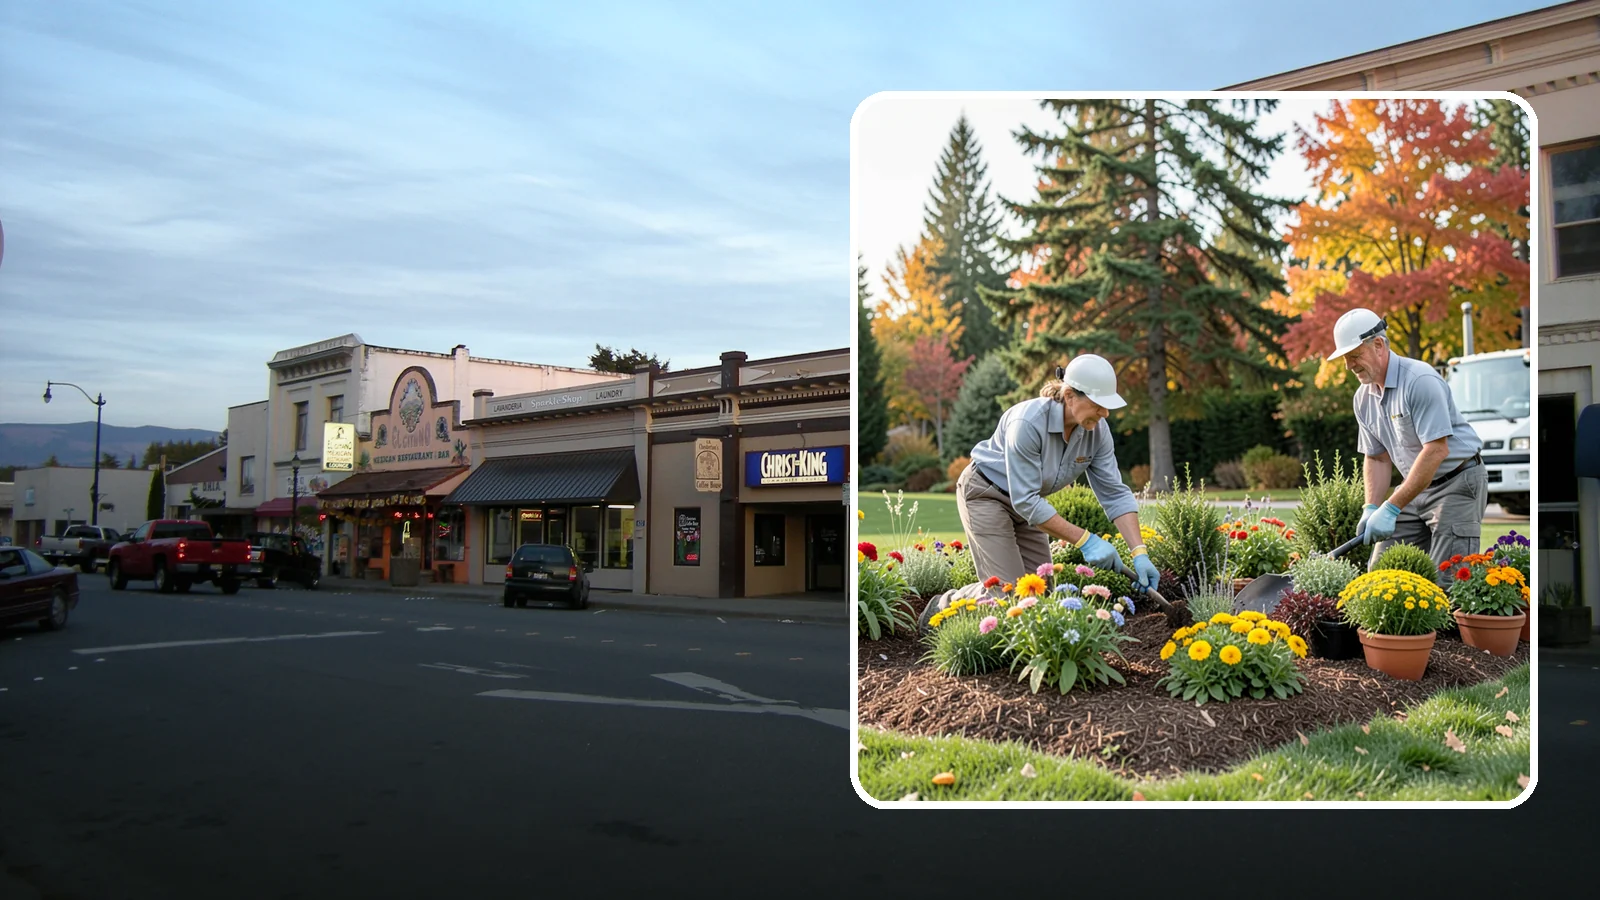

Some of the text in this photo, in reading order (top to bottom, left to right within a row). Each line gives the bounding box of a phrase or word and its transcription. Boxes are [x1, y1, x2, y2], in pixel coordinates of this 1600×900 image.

[595, 389, 624, 400] LAUNDRY
[493, 402, 522, 413] LAVANDERIA
[373, 450, 450, 464] MEXICAN RESTAURANT BAR
[760, 450, 827, 478] CHRIST KING
